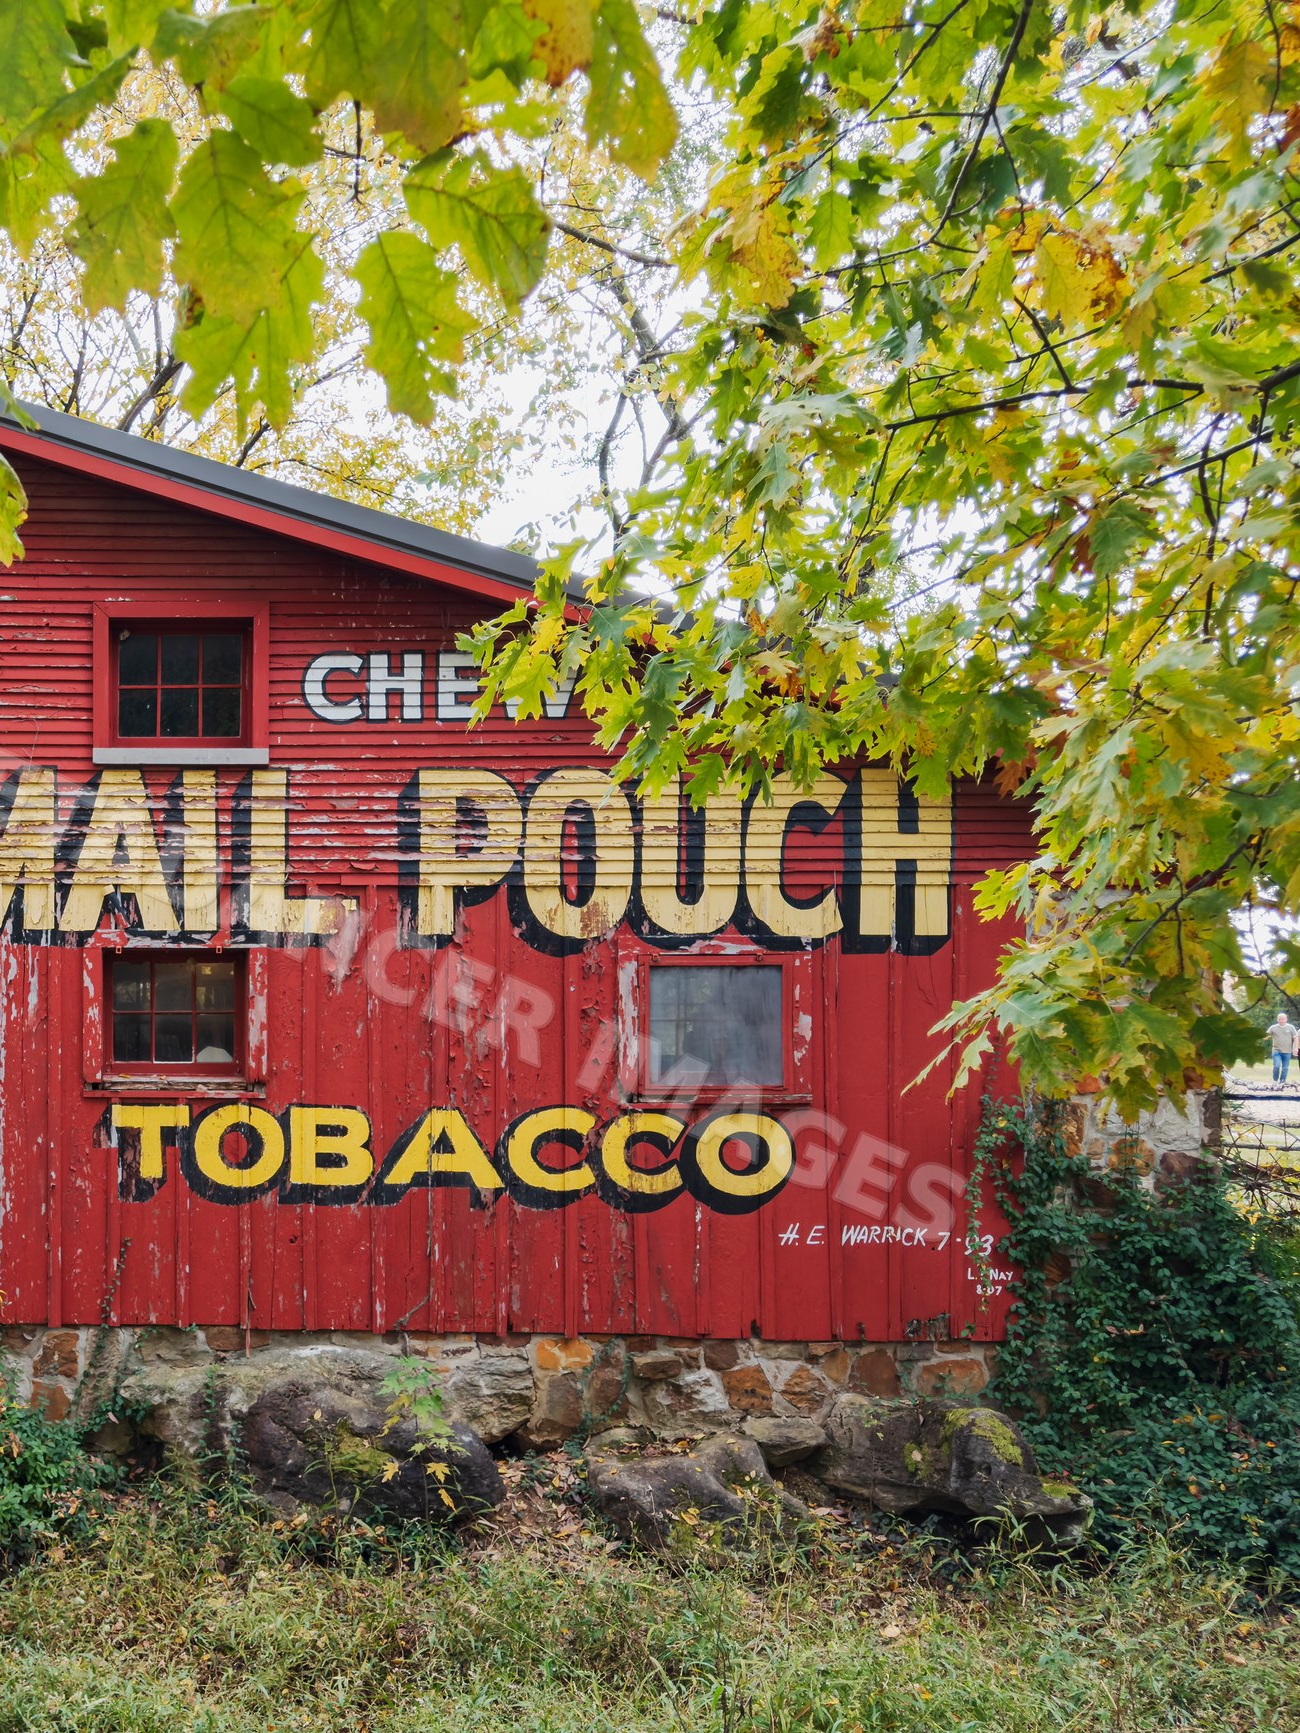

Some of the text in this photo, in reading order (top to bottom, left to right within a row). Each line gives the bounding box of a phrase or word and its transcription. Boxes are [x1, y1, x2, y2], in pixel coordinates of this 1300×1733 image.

[399, 767, 953, 957] POUCH
[100, 1103, 796, 1214] TOBACCO
[842, 1225, 928, 1247] WARRICK
